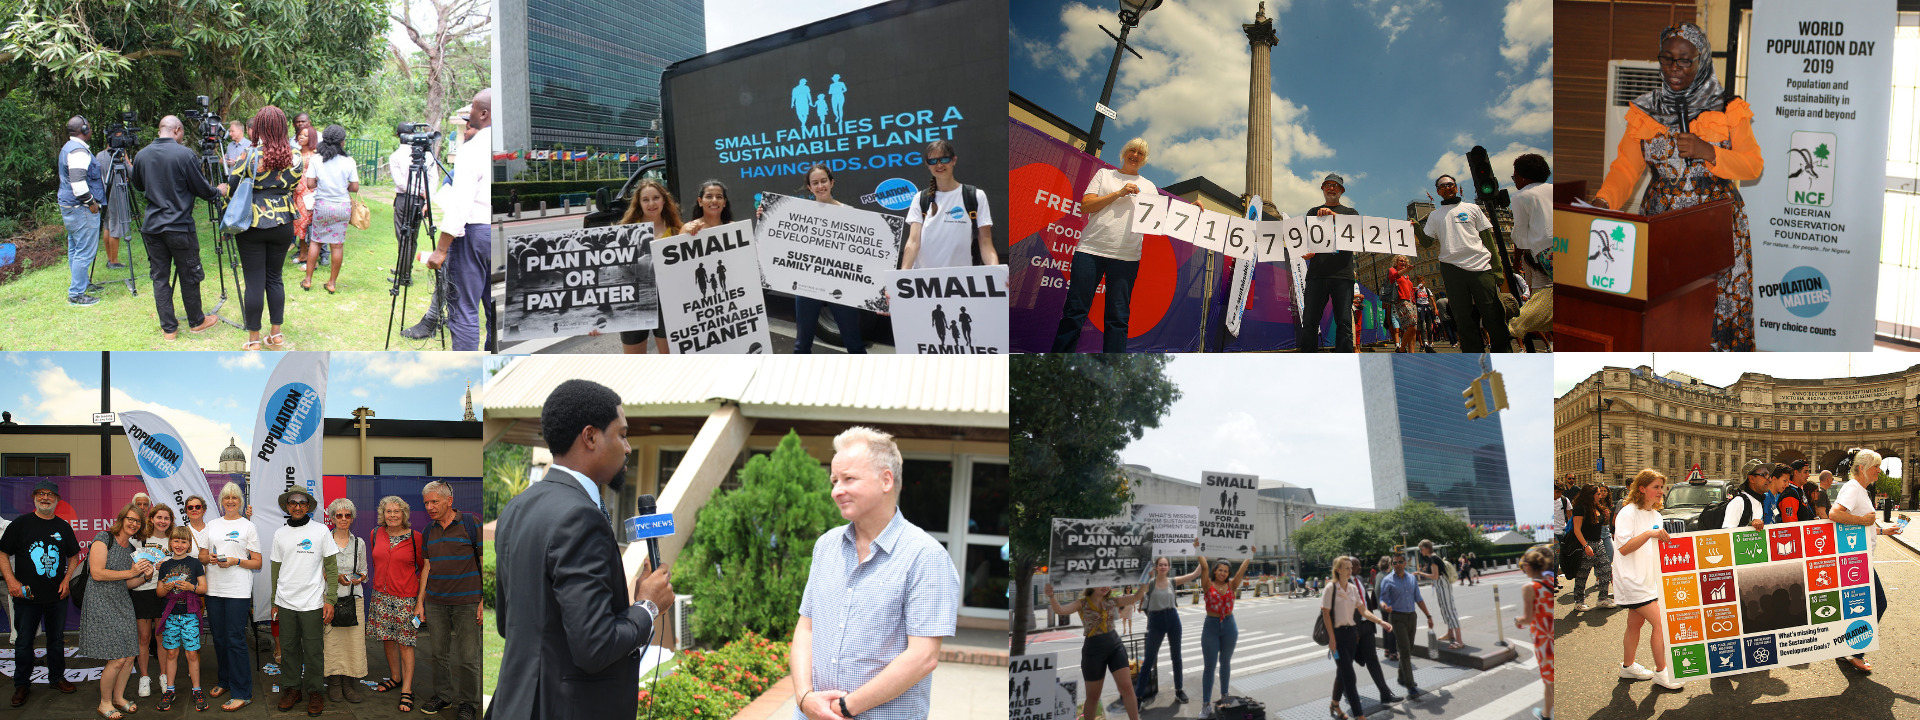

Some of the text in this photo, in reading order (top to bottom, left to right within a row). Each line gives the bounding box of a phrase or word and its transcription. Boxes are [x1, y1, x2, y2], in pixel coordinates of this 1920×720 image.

[1799, 21, 1844, 36] WORLD
[1766, 39, 1875, 56] POPULATION DAY
[1803, 58, 1834, 74] 2019
[1787, 78, 1848, 90] Population and
[1783, 93, 1850, 106] sustainability in
[1775, 106, 1856, 121] Nigeria and beyond
[715, 105, 964, 150] SMALL FAMILIES FOR A
[718, 124, 959, 164] SUSTAINABLE PLANET
[861, 185, 910, 204] POPULATION
[880, 192, 916, 206] MATTERS
[1794, 190, 1825, 205] NCF
[1035, 189, 1082, 217] FREE
[1784, 207, 1831, 219] NIGERIAN
[789, 212, 875, 236] WHAT'S MISSING
[1047, 223, 1082, 240] FOOD
[1770, 217, 1845, 232] CONSERVATION
[778, 221, 883, 248] FROM SUSTAINABLE
[1774, 230, 1838, 244] FOUNDATION
[662, 229, 750, 265] SMALL
[768, 229, 890, 260] DEVELOPMENT GOALS?
[526, 247, 636, 272] PLAN NOW
[787, 251, 863, 273] SUSTAINABLE
[565, 270, 596, 287] OR
[772, 257, 875, 285] FAMILY PLANNING.
[896, 275, 1006, 299] SMALL
[1040, 275, 1063, 289] BIG
[1592, 274, 1615, 288] NCF
[1758, 277, 1822, 298] POPULATION
[526, 285, 635, 311] PAY LATER
[683, 287, 745, 314] FAMILIES
[1783, 289, 1831, 309] MATTERS
[696, 301, 738, 322] FOR A
[670, 304, 764, 342] SUSTAINABLE
[1760, 318, 1836, 336] Every choice counts
[678, 317, 759, 354] PLANET
[283, 389, 317, 444] MATTERS
[258, 388, 302, 462] POPULATION
[128, 424, 179, 464] POPULATION
[138, 444, 176, 476] MATTERS
[1206, 475, 1255, 490] SMALL
[173, 490, 184, 506] For
[1210, 508, 1246, 517] FAMILIES
[636, 522, 650, 530] TVC
[652, 520, 673, 528] NEWS
[1200, 521, 1254, 531] SUSTAINABLE
[1068, 535, 1143, 546] PLAN NOW
[1202, 528, 1250, 539] PLANET
[1736, 534, 1741, 542] 3
[1700, 538, 1704, 546] 2
[1095, 547, 1116, 558] OR
[1067, 558, 1139, 571] PAY LATER
[1666, 578, 1670, 586] 7
[1702, 574, 1707, 582] 8
[1843, 591, 1850, 599] 14
[1669, 614, 1675, 622] 11
[1706, 610, 1713, 618] 12
[1778, 631, 1796, 639] What's
[1797, 628, 1817, 636] missing
[1833, 624, 1868, 646] POPULATION
[1848, 630, 1873, 647] MATTERS
[1710, 644, 1717, 652] 16
[1746, 639, 1752, 647] 17
[1788, 637, 1818, 646] Sustainable
[1674, 649, 1680, 657] 15
[1780, 646, 1813, 656] Development
